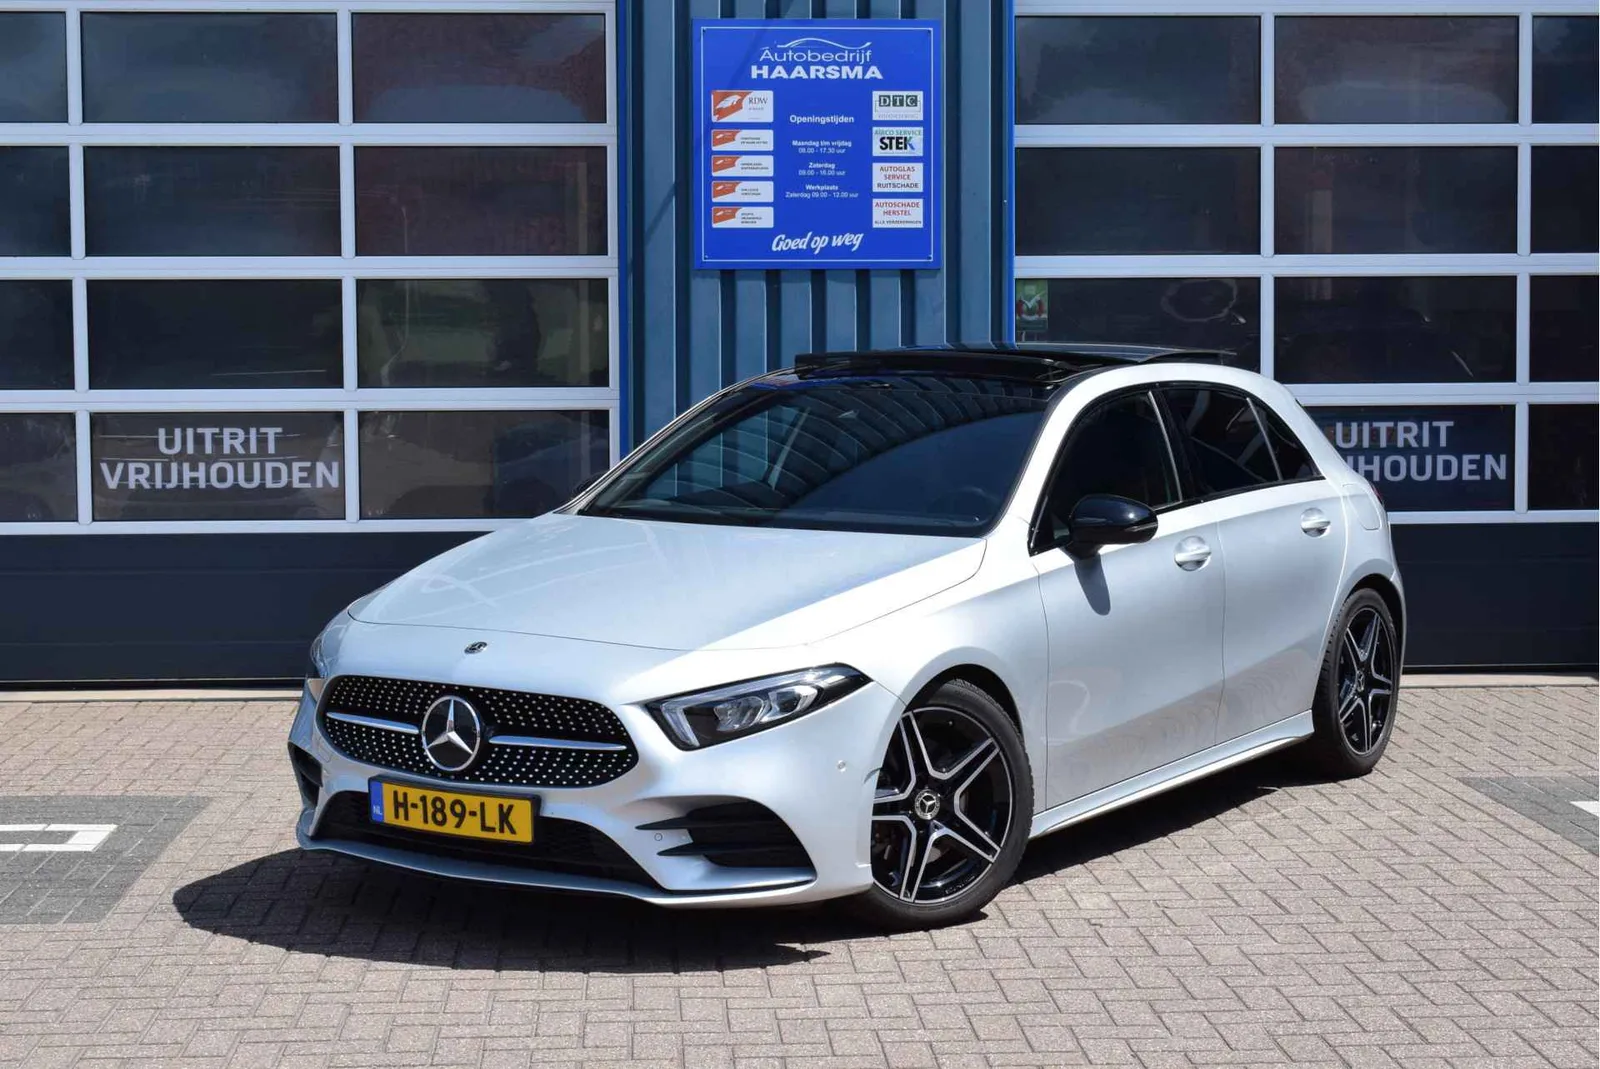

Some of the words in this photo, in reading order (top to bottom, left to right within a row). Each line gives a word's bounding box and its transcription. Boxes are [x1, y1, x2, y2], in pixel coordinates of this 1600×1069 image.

[759, 49, 872, 63] Autobedrijf
[751, 65, 883, 79] HAARSMA
[879, 95, 917, 107] DTC
[789, 114, 855, 125] Openingstijden
[792, 140, 819, 148] Maandag
[831, 140, 852, 148] vrijdag
[879, 136, 915, 150] STEK
[785, 191, 811, 199] Zaterdag
[771, 231, 813, 251] Goed
[810, 235, 829, 255] op
[831, 233, 864, 252] weg
[157, 427, 283, 455] UITRIT
[1335, 421, 1454, 448] UITRIT
[1345, 454, 1507, 481] HOUDEN
[100, 462, 339, 489] VRIJHOUDEN
[373, 806, 383, 816] NL
[393, 790, 517, 835] H-189-LK
